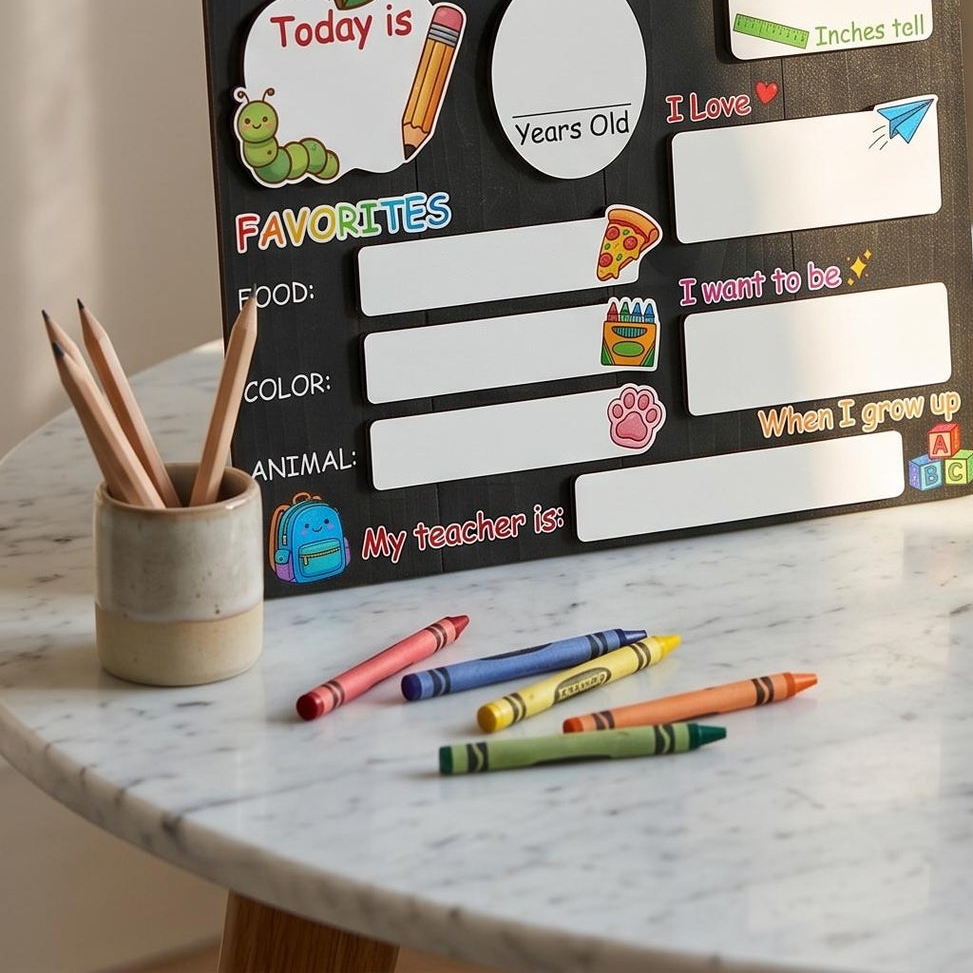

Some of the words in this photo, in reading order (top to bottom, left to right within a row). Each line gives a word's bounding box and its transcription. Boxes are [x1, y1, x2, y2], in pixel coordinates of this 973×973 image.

[270, 9, 372, 50] Today
[386, 5, 412, 37] is
[815, 21, 885, 46] Inches
[892, 14, 924, 38] tell
[666, 95, 684, 124] I
[690, 92, 751, 120] Love
[515, 116, 581, 145] Years
[589, 112, 630, 139] Old
[235, 192, 452, 254] FAVORITES
[238, 281, 314, 311] FOOD:
[679, 277, 698, 306] I
[701, 272, 765, 303] want
[771, 268, 800, 295] to
[807, 261, 842, 291] be
[243, 373, 331, 403] COLOR:
[758, 403, 834, 438] When
[837, 399, 857, 429] I
[861, 395, 925, 431] grow
[929, 390, 961, 423] up
[931, 430, 950, 455] A
[252, 447, 357, 481] ANIMAL:
[361, 525, 407, 564] My
[413, 510, 526, 549] teacher
[533, 504, 565, 534] is:
